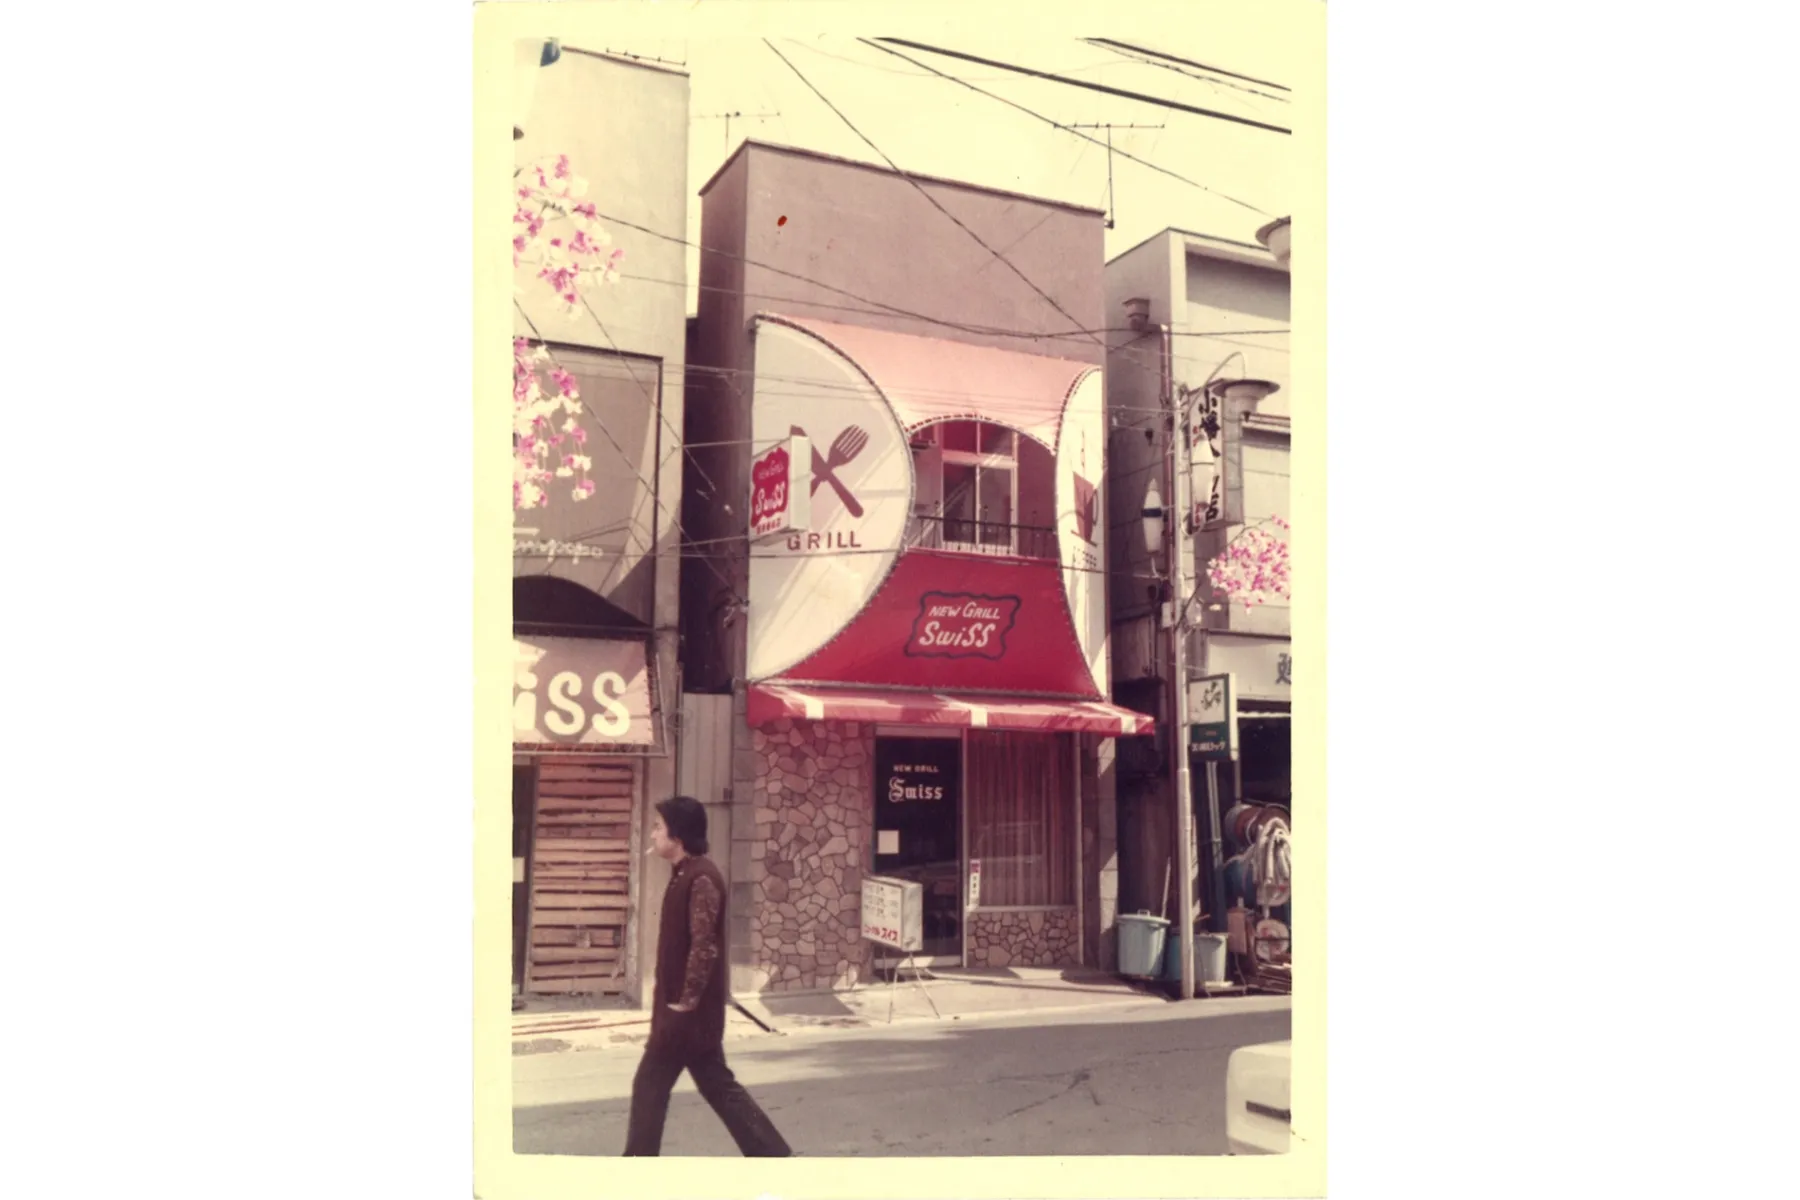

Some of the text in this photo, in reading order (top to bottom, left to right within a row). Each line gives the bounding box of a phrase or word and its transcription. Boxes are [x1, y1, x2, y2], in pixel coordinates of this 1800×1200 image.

[787, 530, 862, 551] GRILL
[928, 605, 961, 617] NEW
[893, 764, 940, 773] NEW GRILL
[888, 776, 944, 803] Swiss
